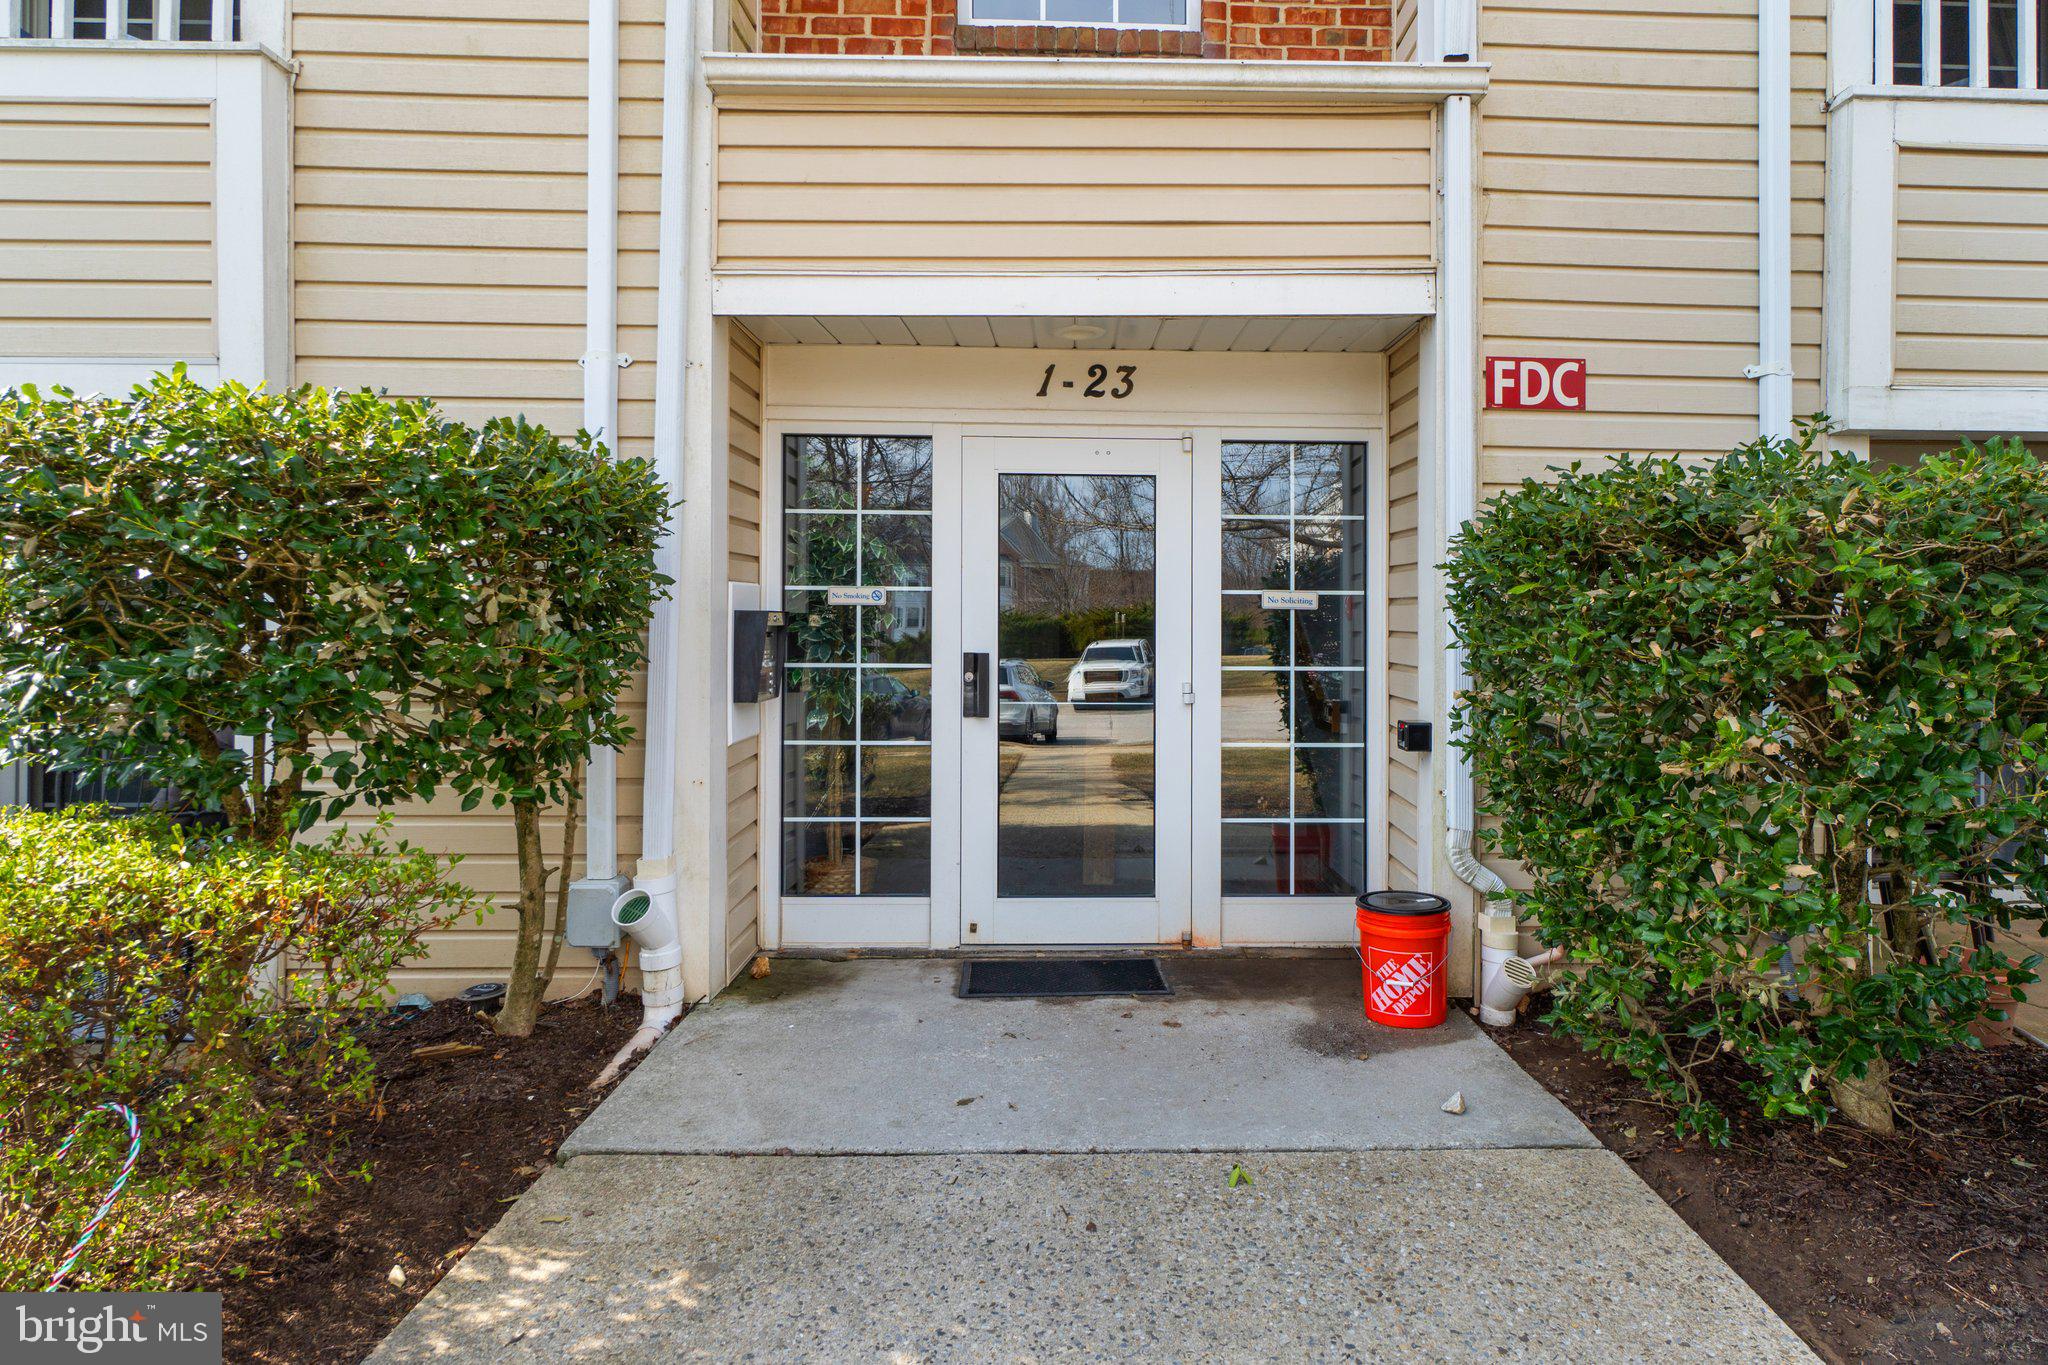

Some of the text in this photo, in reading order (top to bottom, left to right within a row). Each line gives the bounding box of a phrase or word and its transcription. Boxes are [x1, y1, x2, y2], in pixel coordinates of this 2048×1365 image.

[1494, 360, 1579, 407] FDC
[843, 592, 870, 600] Smoking
[1268, 596, 1313, 606] No Soliciting
[1372, 953, 1432, 1012] HOME
[1376, 958, 1400, 982] THE
[1392, 977, 1432, 1015] DEPOT
